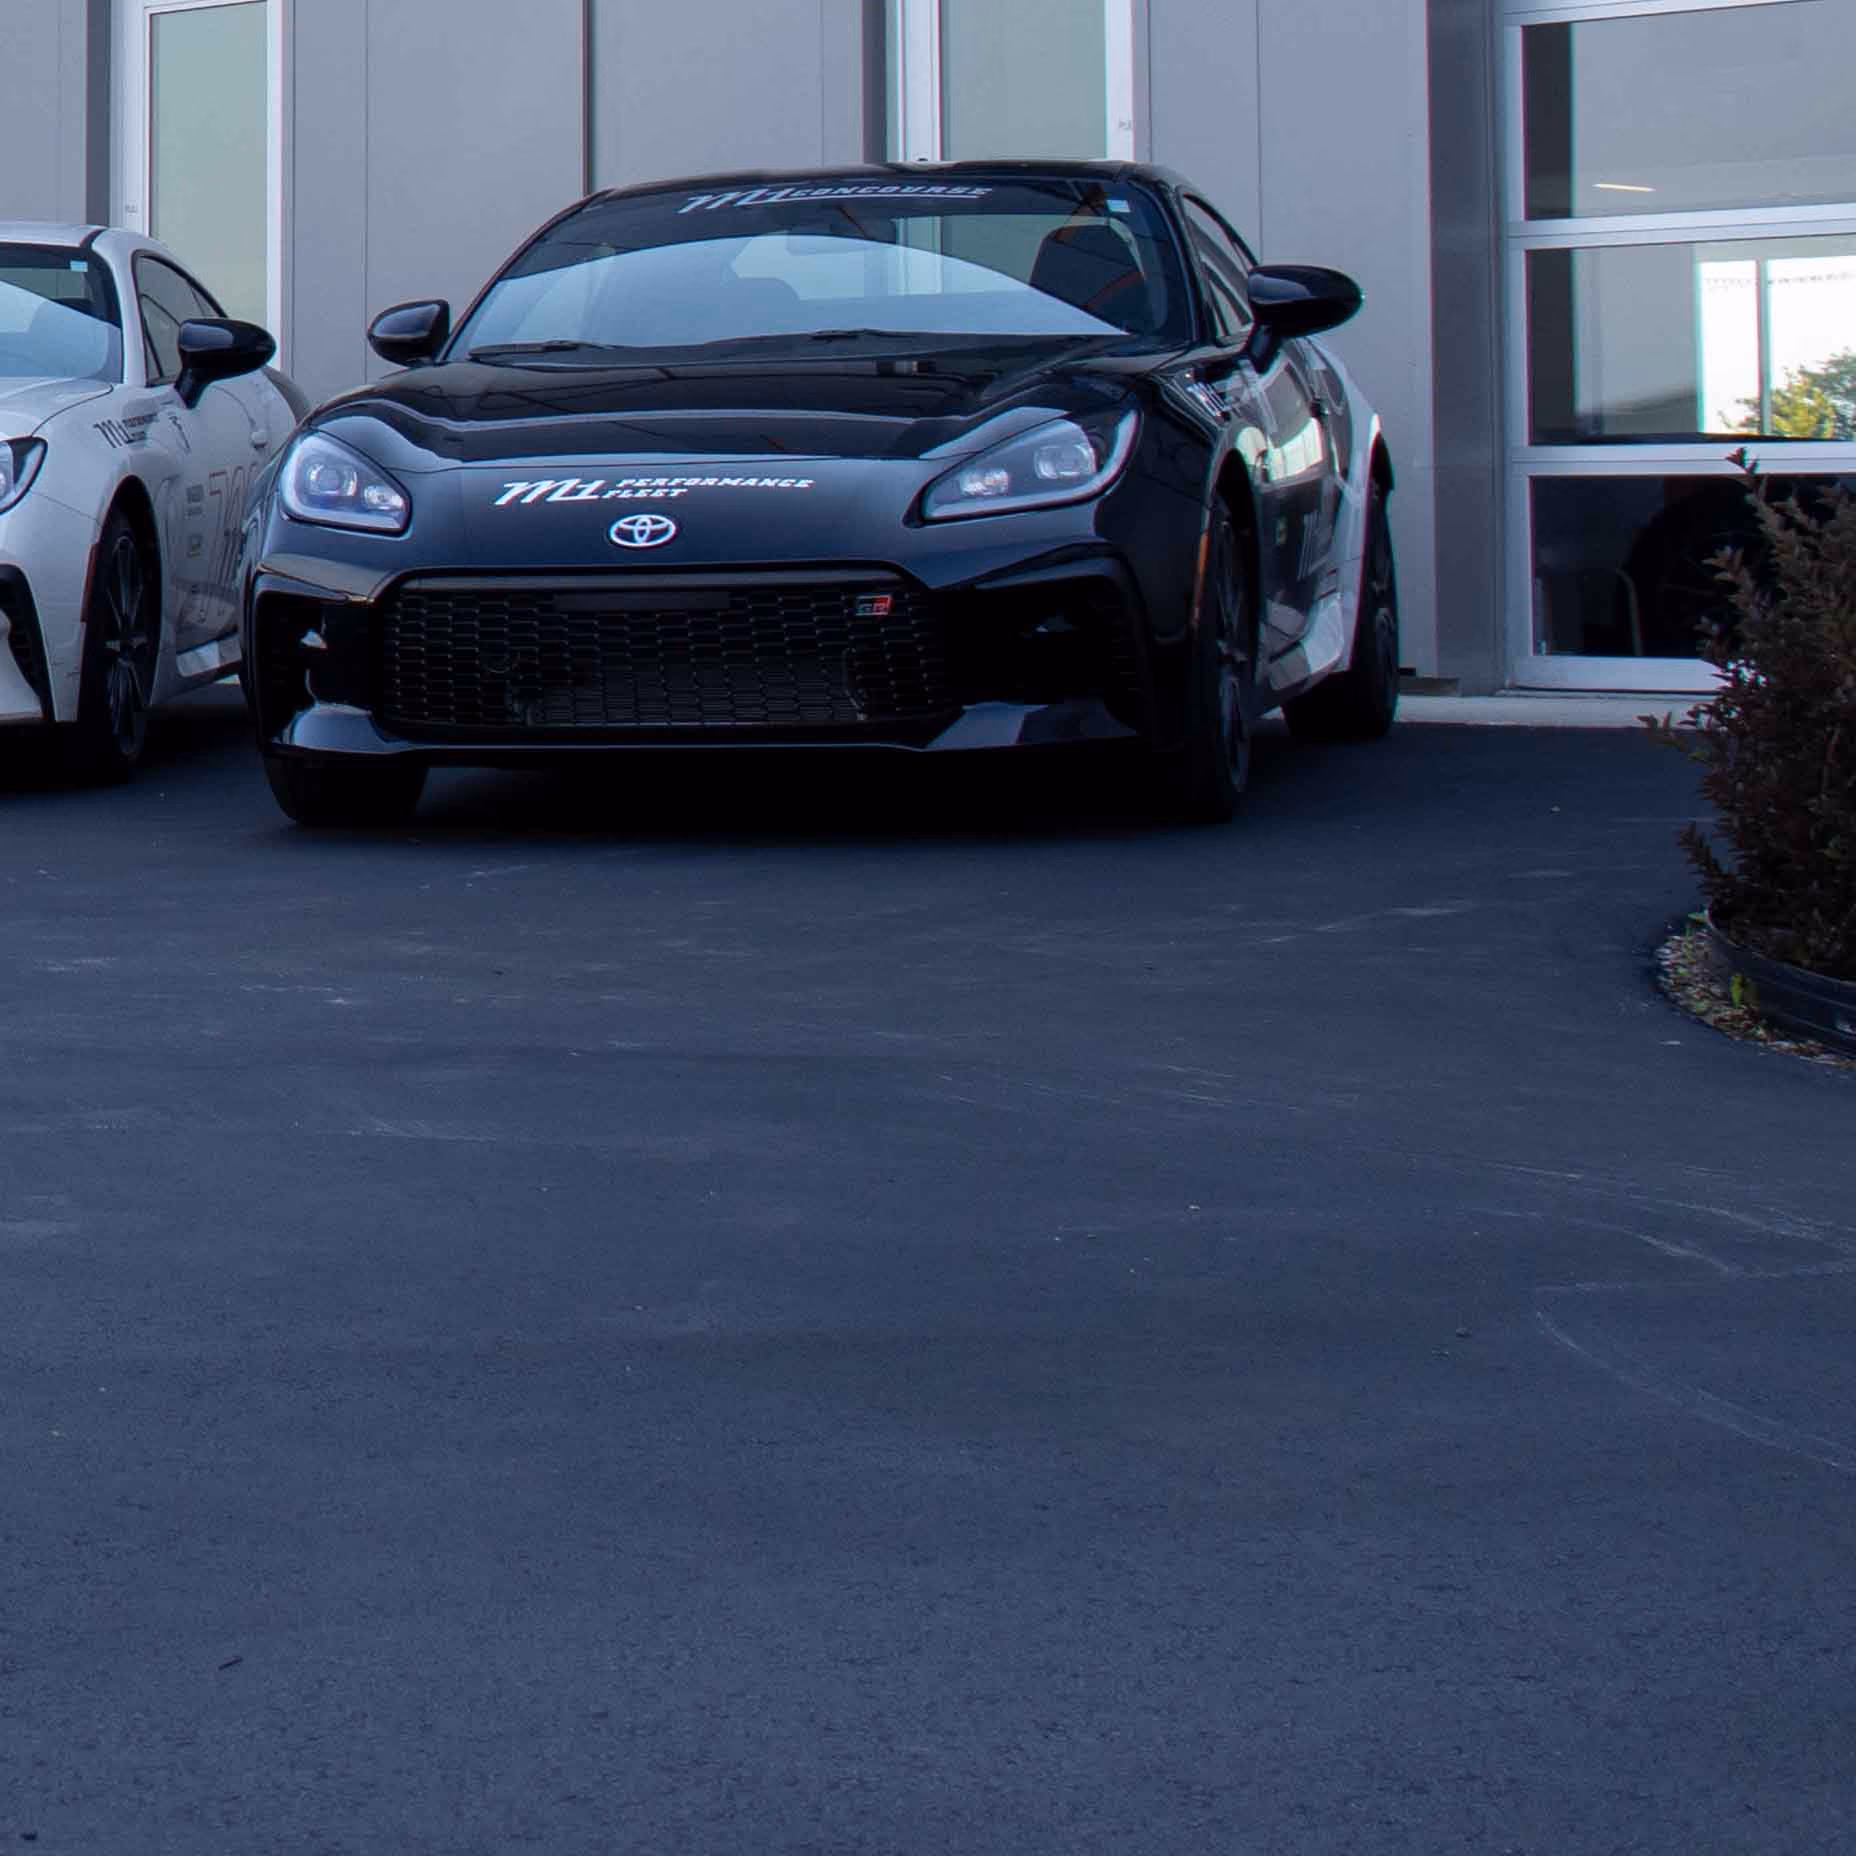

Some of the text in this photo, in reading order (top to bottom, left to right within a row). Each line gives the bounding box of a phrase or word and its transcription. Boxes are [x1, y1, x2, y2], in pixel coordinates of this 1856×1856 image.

[787, 185, 993, 197] CONCOURSE
[494, 477, 815, 507] M1 PERFORMANCE
[602, 488, 689, 500] FLEET
